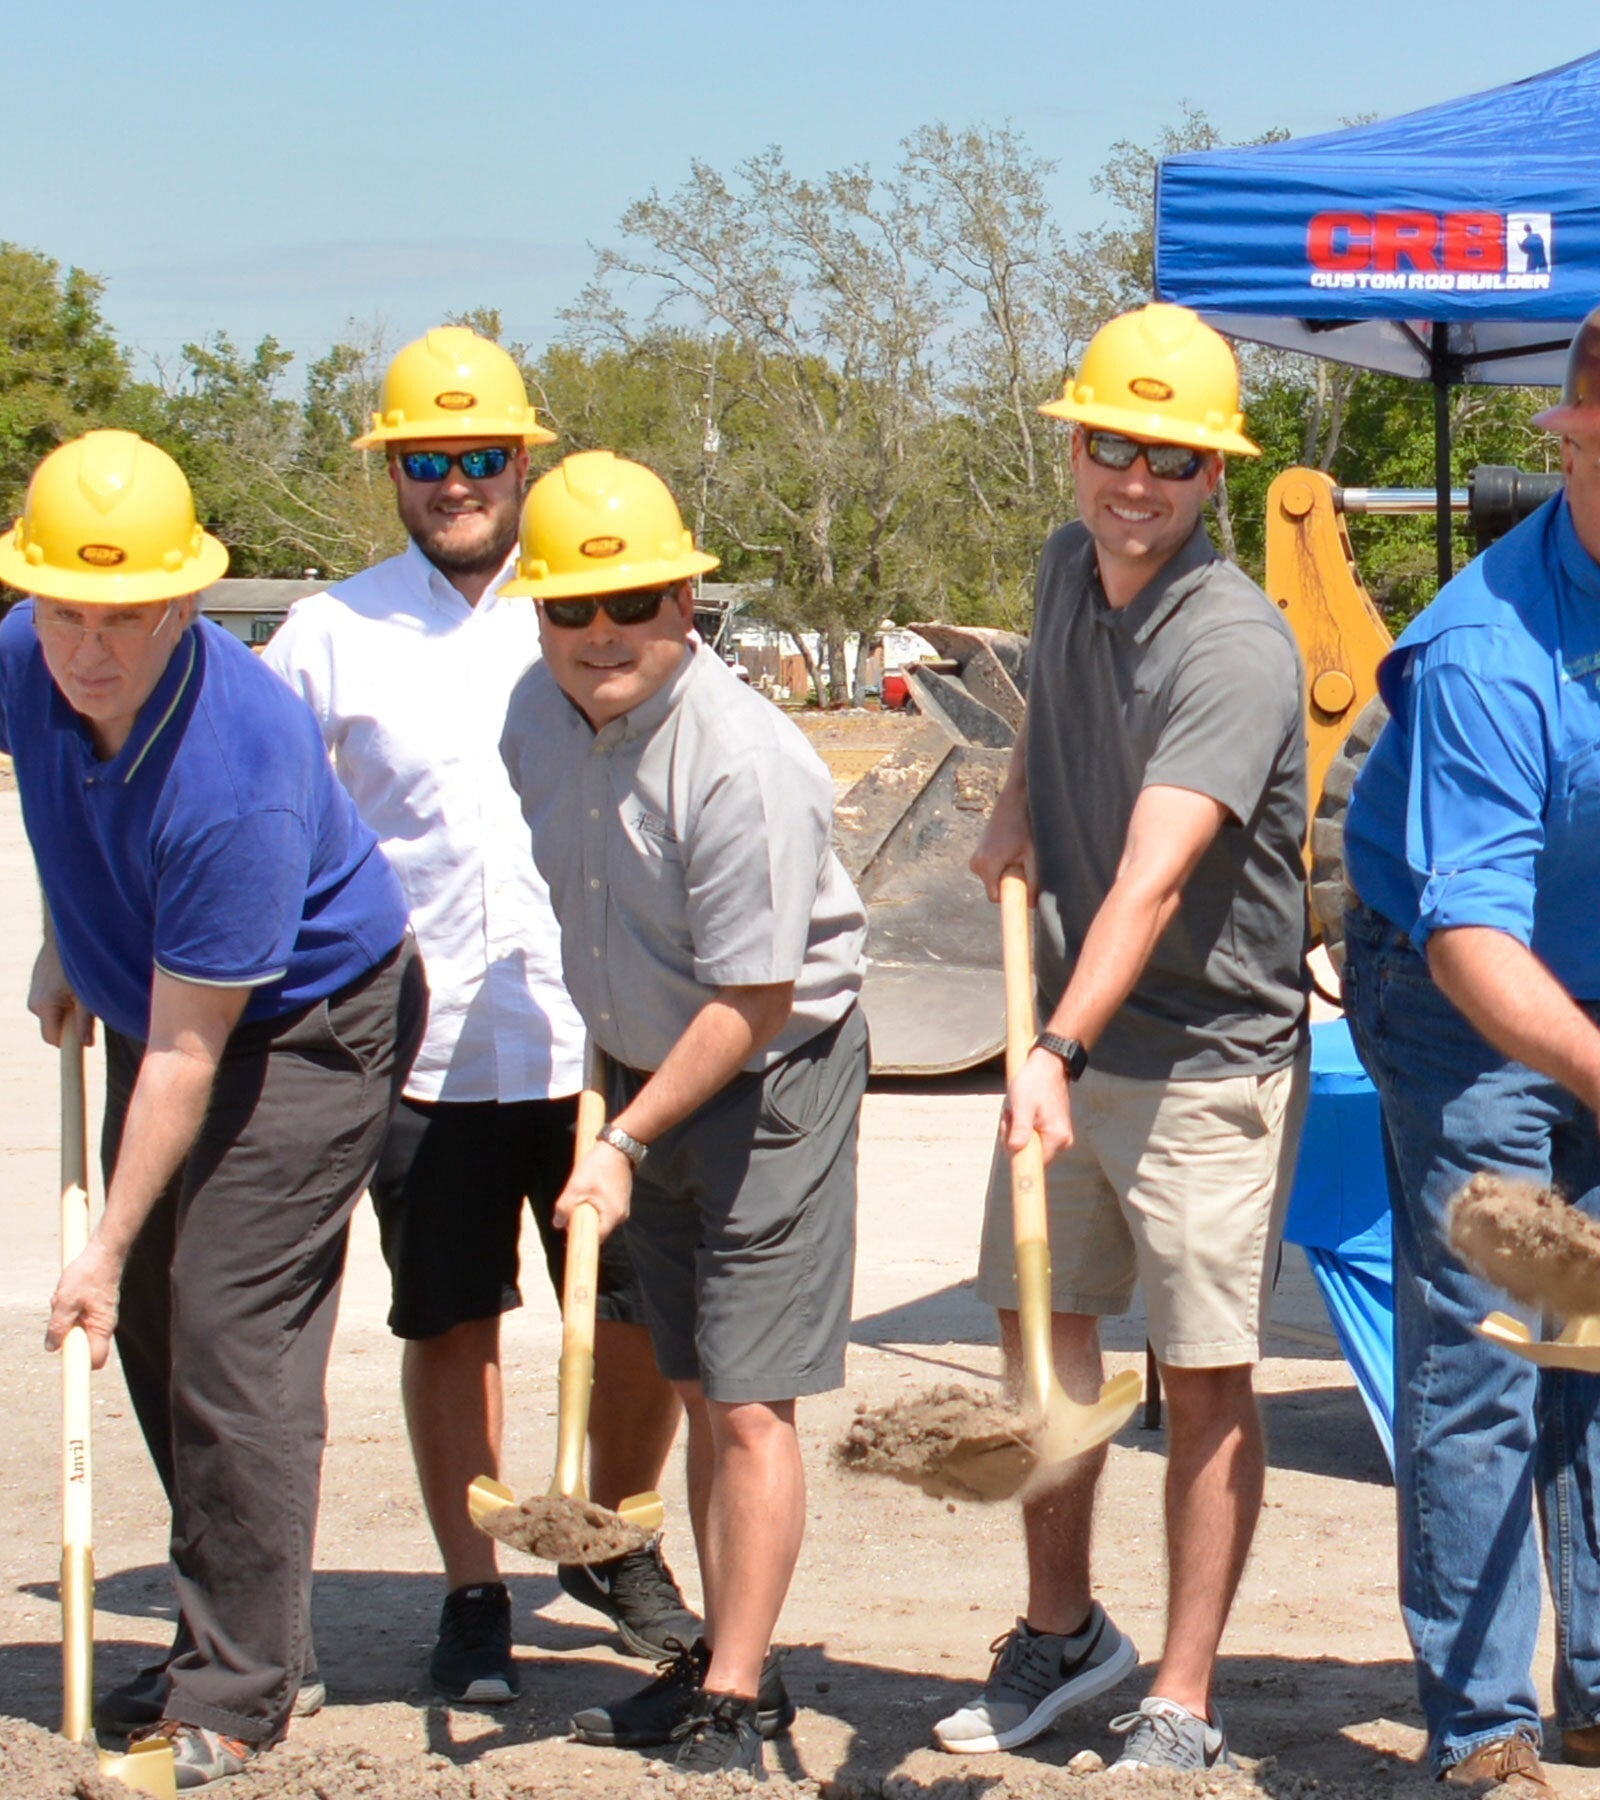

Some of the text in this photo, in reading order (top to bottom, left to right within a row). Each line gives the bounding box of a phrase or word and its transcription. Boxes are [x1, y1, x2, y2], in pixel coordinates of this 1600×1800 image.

[1306, 210, 1507, 272] CRB
[1310, 273, 1550, 289] CUSTOM ROD BUILDER
[69, 1440, 84, 1484] Anvil
